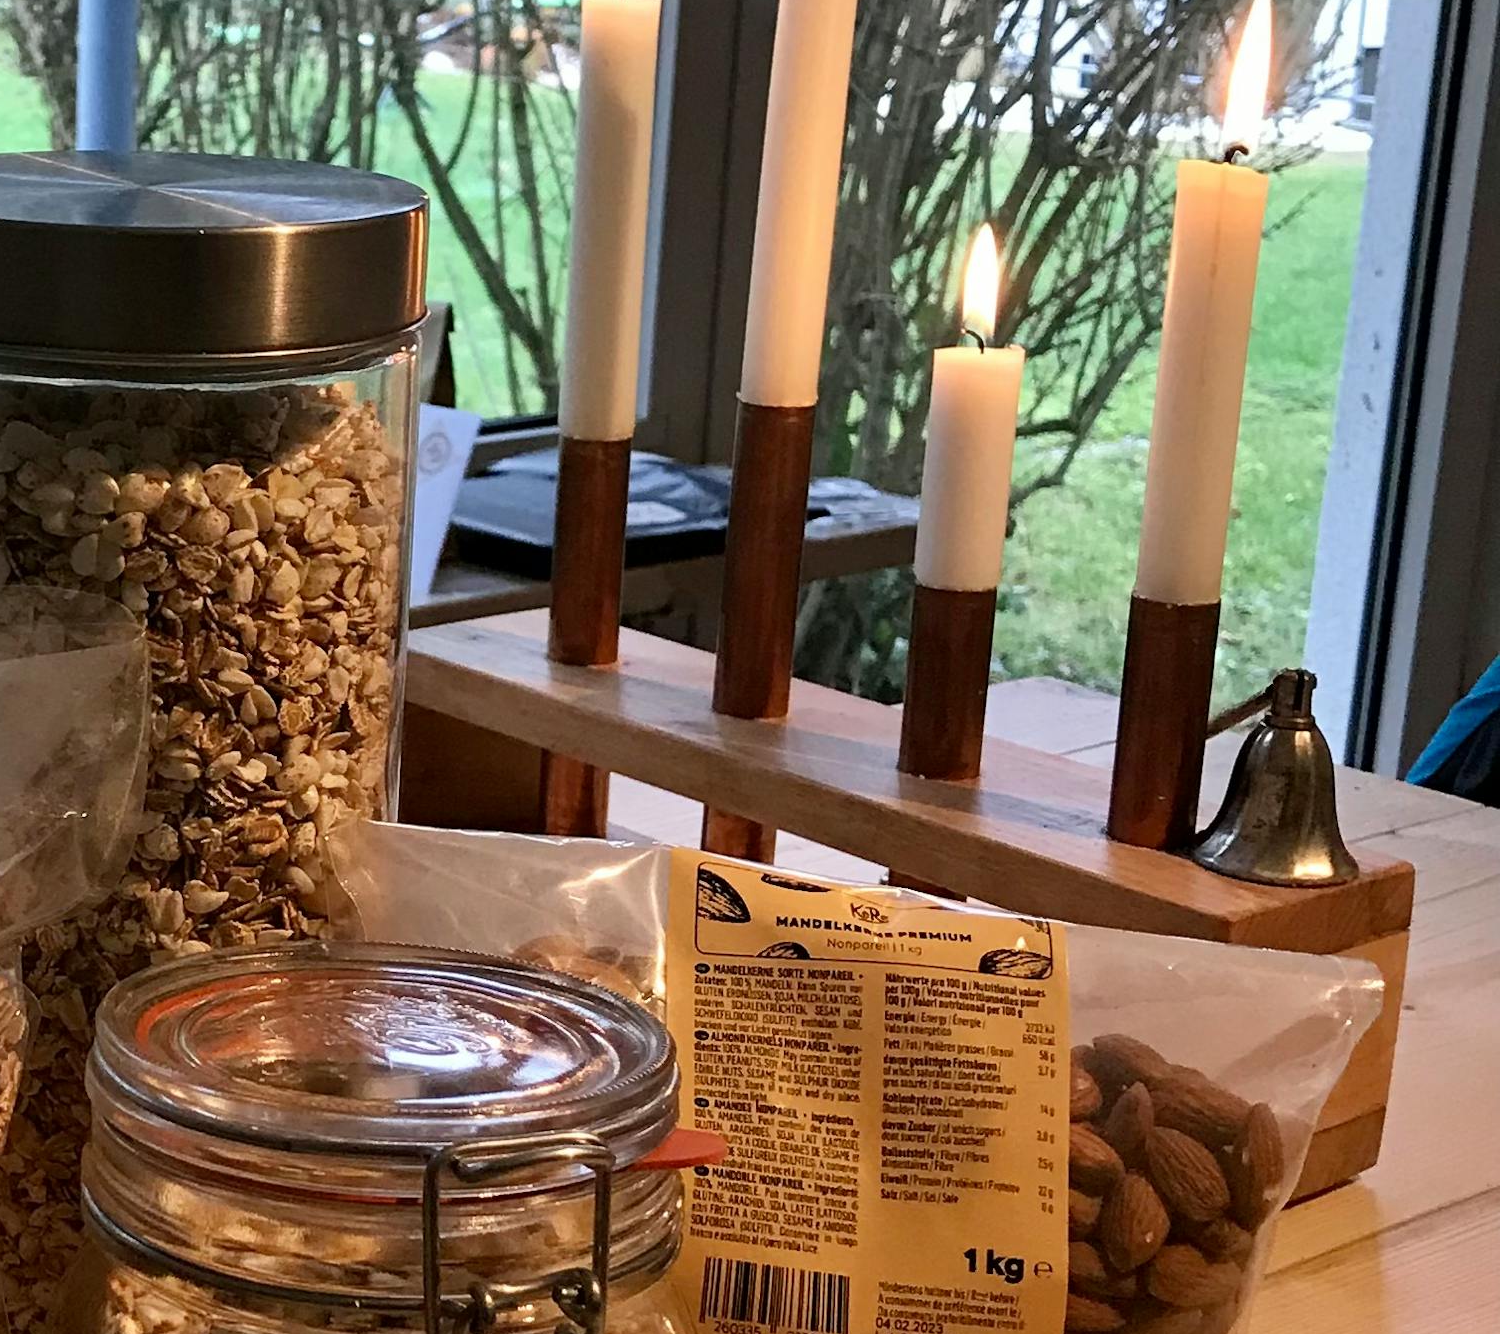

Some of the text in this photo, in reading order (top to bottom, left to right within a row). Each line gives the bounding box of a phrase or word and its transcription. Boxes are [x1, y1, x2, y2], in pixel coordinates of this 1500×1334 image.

[898, 931, 971, 942] PREMIUM
[713, 964, 774, 977] MANDELKERNE
[778, 968, 804, 978] SORTE
[885, 1011, 915, 1023] Energie
[711, 1032, 745, 1042] ALMOND
[884, 1038, 900, 1049] Fett
[881, 1189, 898, 1199] Salz
[964, 1248, 1024, 1284] 1 kg
[876, 1318, 943, 1334] 04.02.2023
